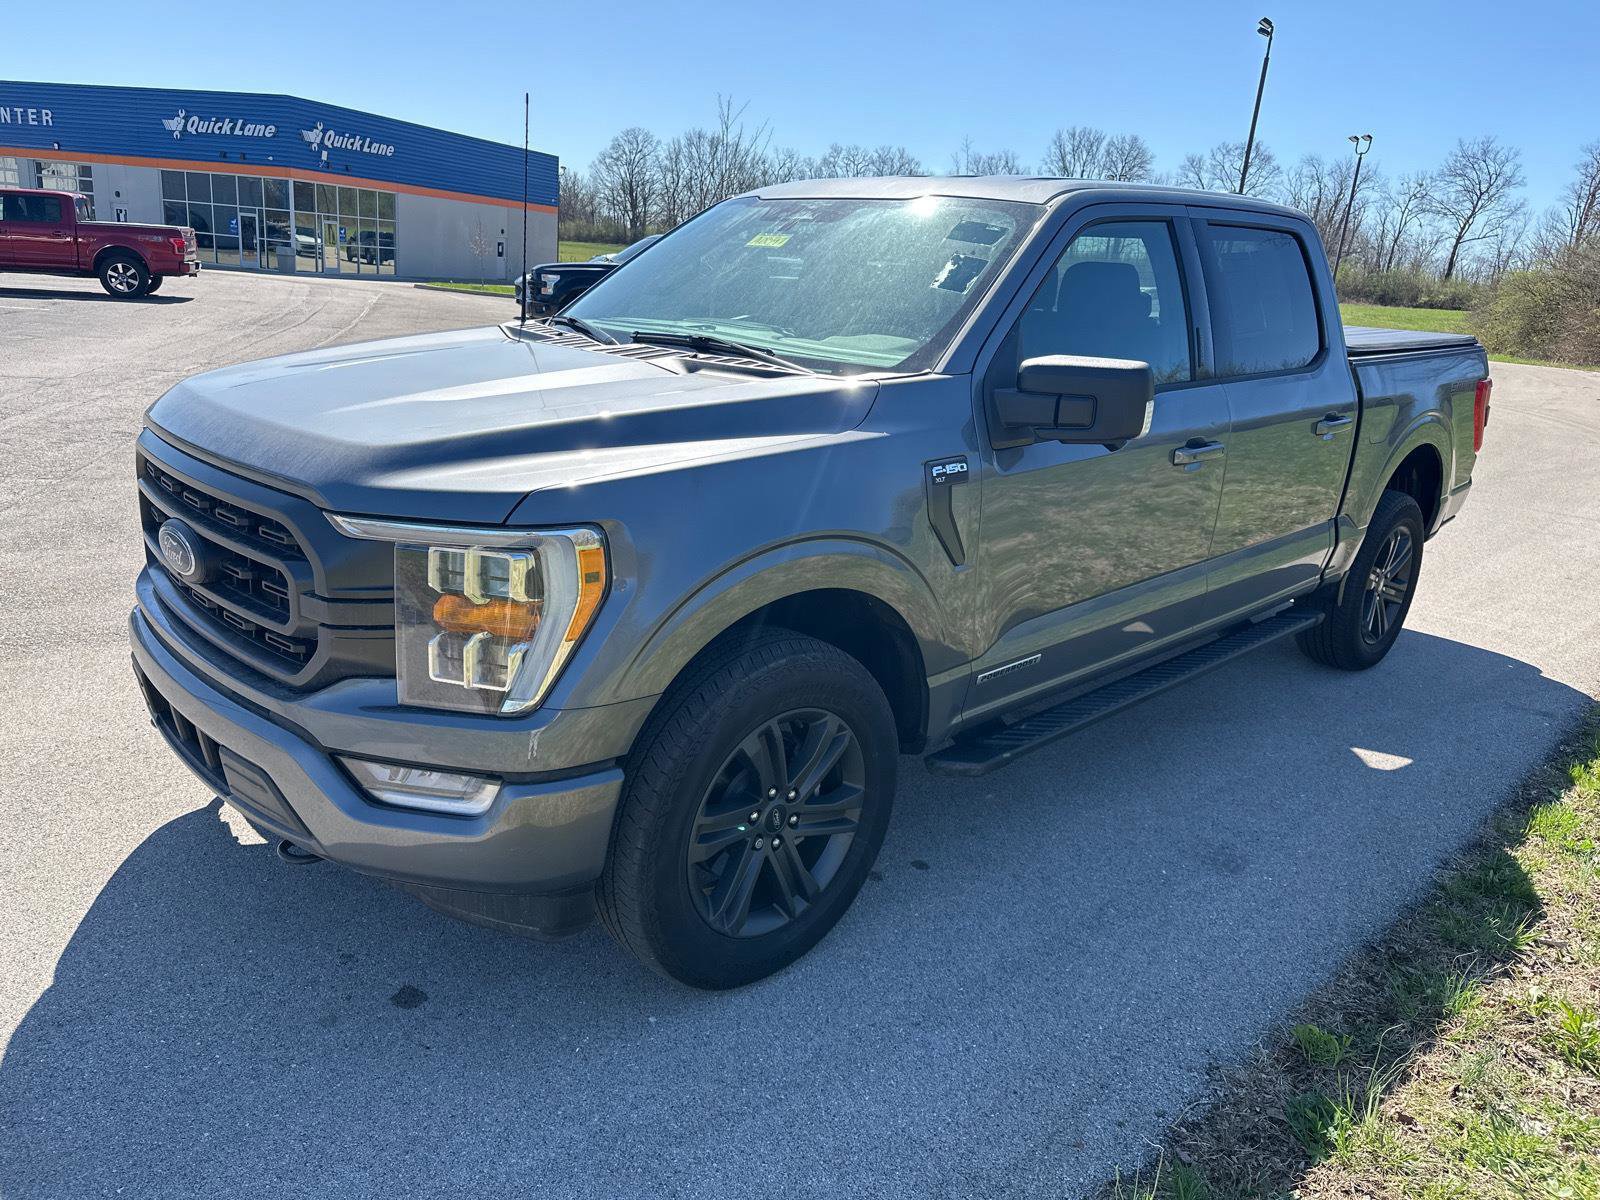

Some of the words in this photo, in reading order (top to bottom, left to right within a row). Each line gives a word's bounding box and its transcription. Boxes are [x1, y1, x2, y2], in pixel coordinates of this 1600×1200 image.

[0, 108, 53, 126] NTER
[186, 115, 233, 134] Quick
[233, 119, 276, 138] Lane
[324, 129, 362, 151] Quick
[362, 136, 395, 157] Lane
[932, 463, 967, 477] F-150
